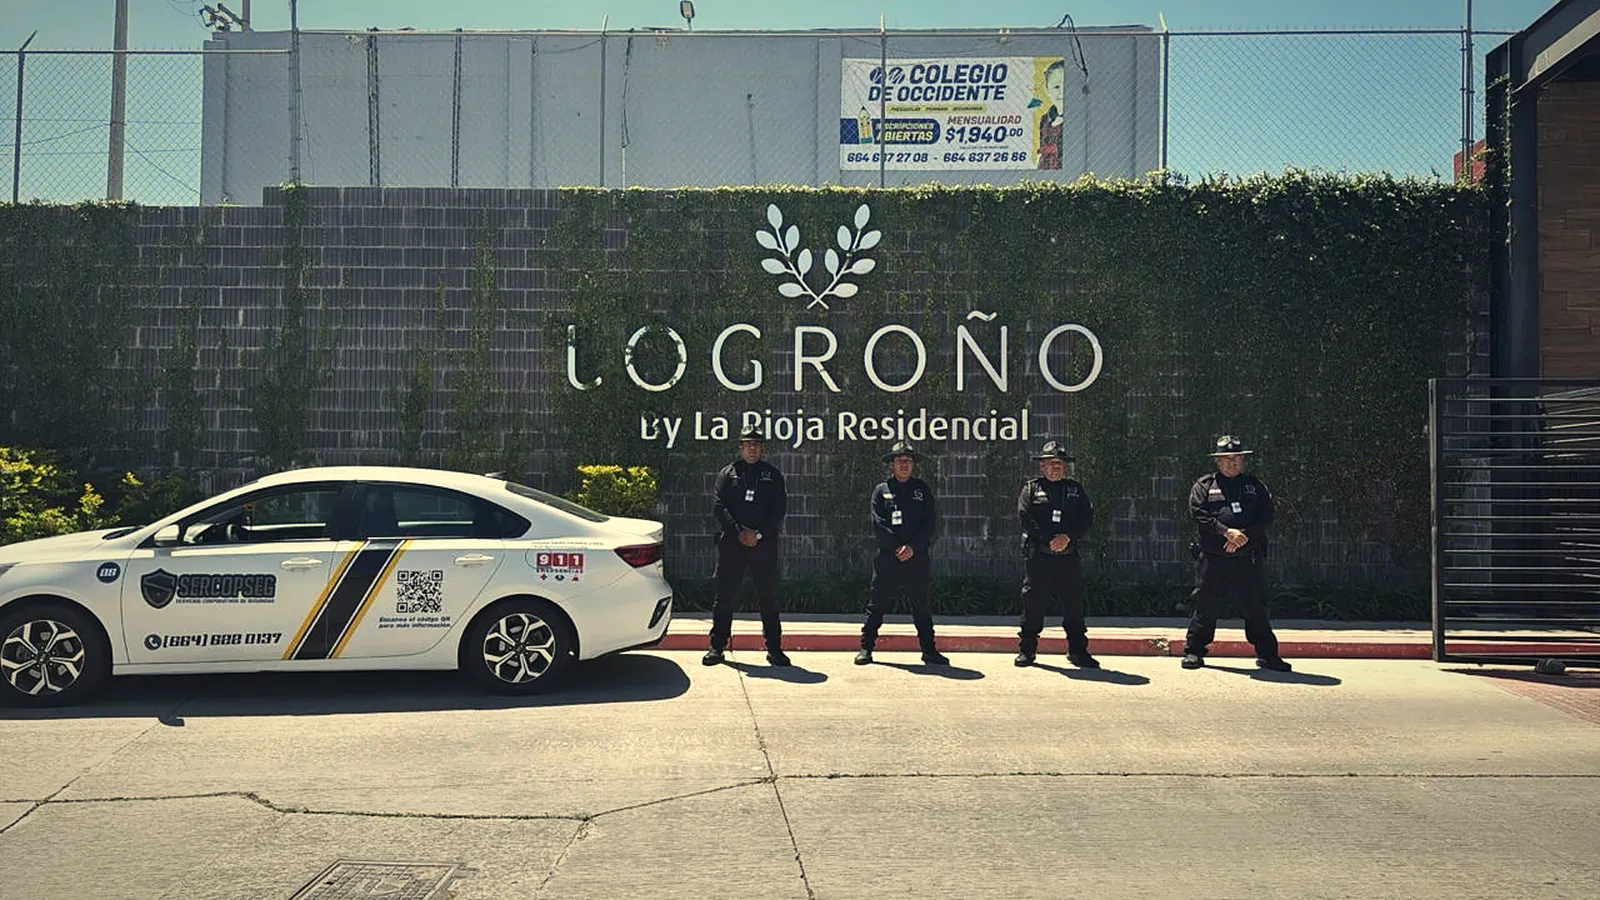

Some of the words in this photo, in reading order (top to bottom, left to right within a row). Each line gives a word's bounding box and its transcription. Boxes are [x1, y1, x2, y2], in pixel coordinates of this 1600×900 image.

[910, 64, 1008, 84] COLEGIO
[868, 86, 894, 101] DE
[897, 85, 1007, 101] OCCIDENTE
[947, 115, 1022, 125] MENSUALIDAD
[847, 152, 870, 162] 664
[896, 152, 912, 162] 27
[912, 152, 929, 162] 08
[943, 152, 966, 163] 664
[968, 152, 991, 163] 637
[566, 310, 1104, 393] LOGROÑO
[694, 411, 729, 440] La
[838, 409, 1030, 442] Residencial
[537, 553, 583, 567] 911
[100, 568, 117, 577] 08
[178, 574, 277, 598] SERCOPSEG
[244, 632, 283, 645] 0137
